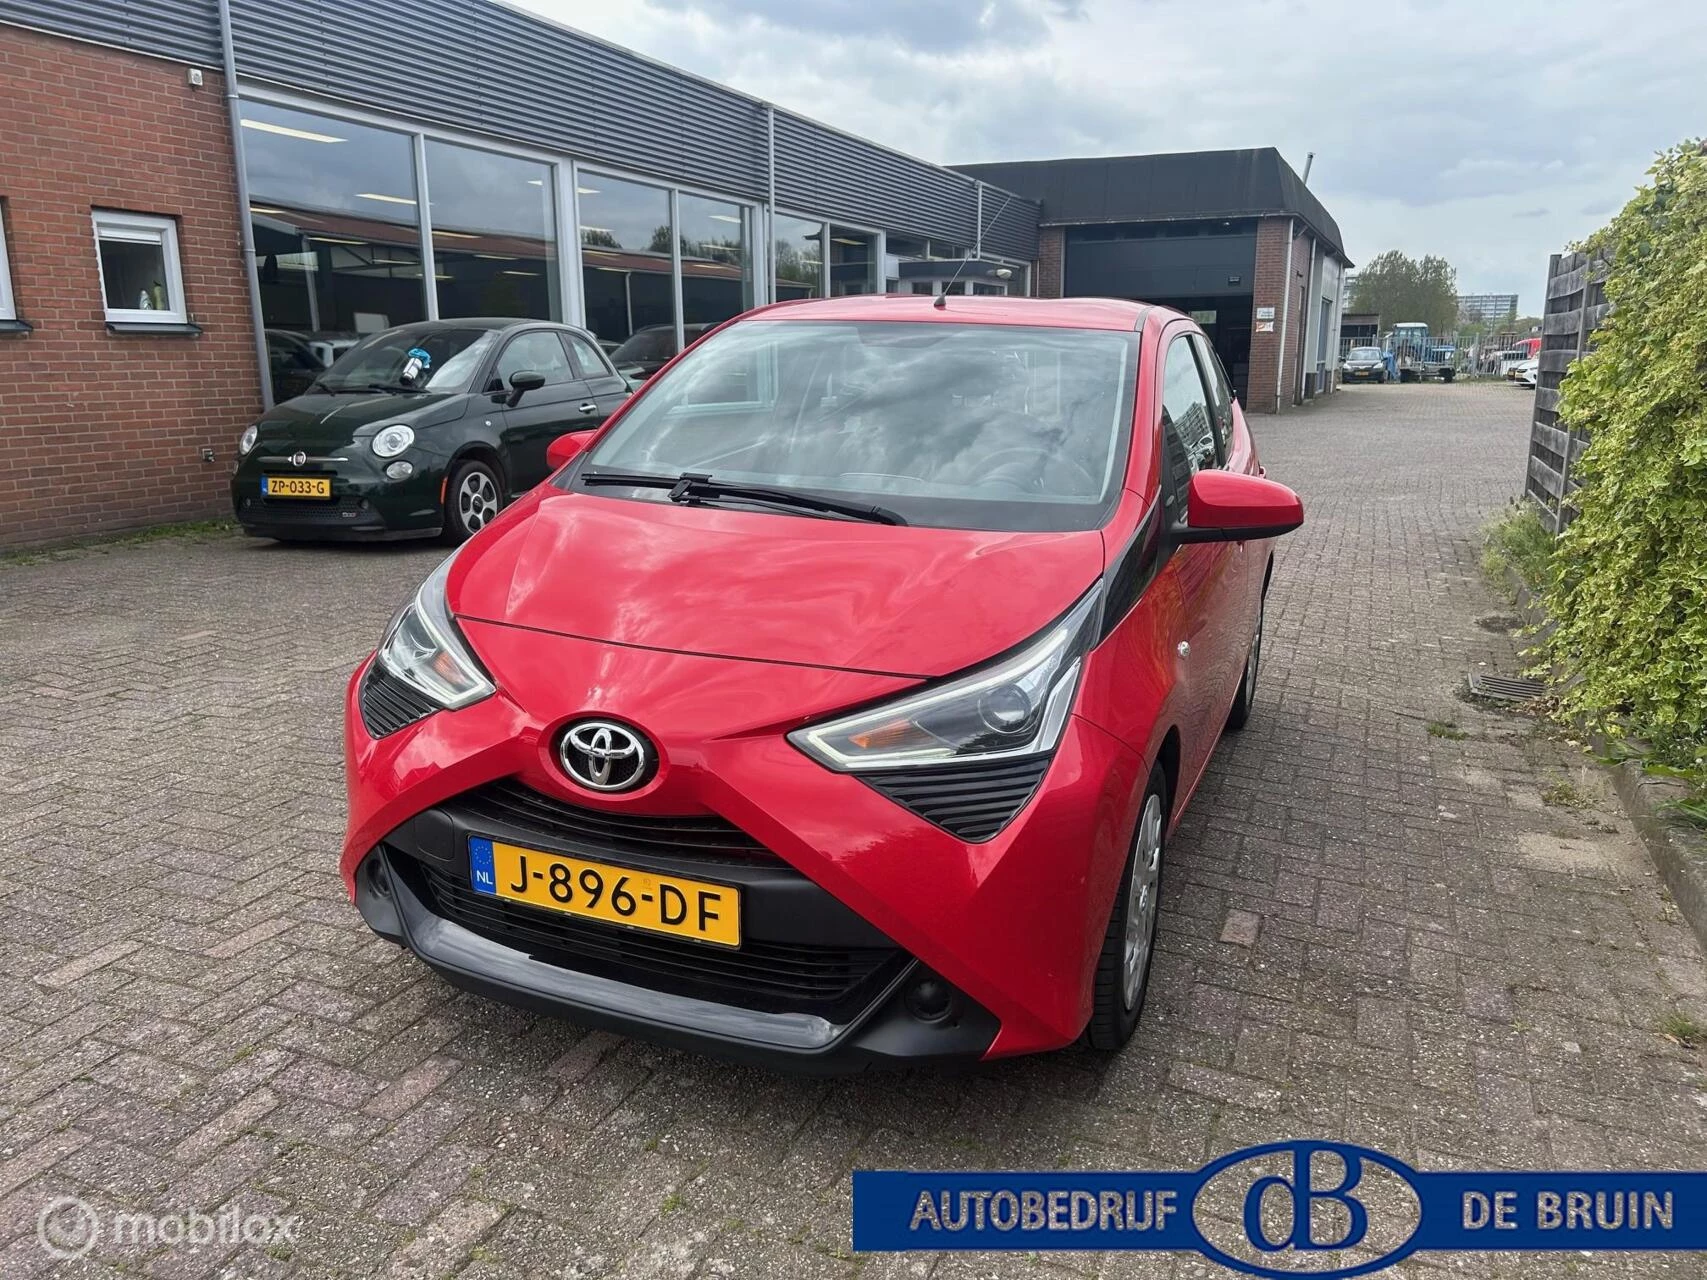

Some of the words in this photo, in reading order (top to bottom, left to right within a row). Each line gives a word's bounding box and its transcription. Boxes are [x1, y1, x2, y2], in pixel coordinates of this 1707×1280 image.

[271, 480, 325, 494] ZP-033-G
[476, 869, 494, 885] NL
[510, 855, 721, 932] J-896-DF
